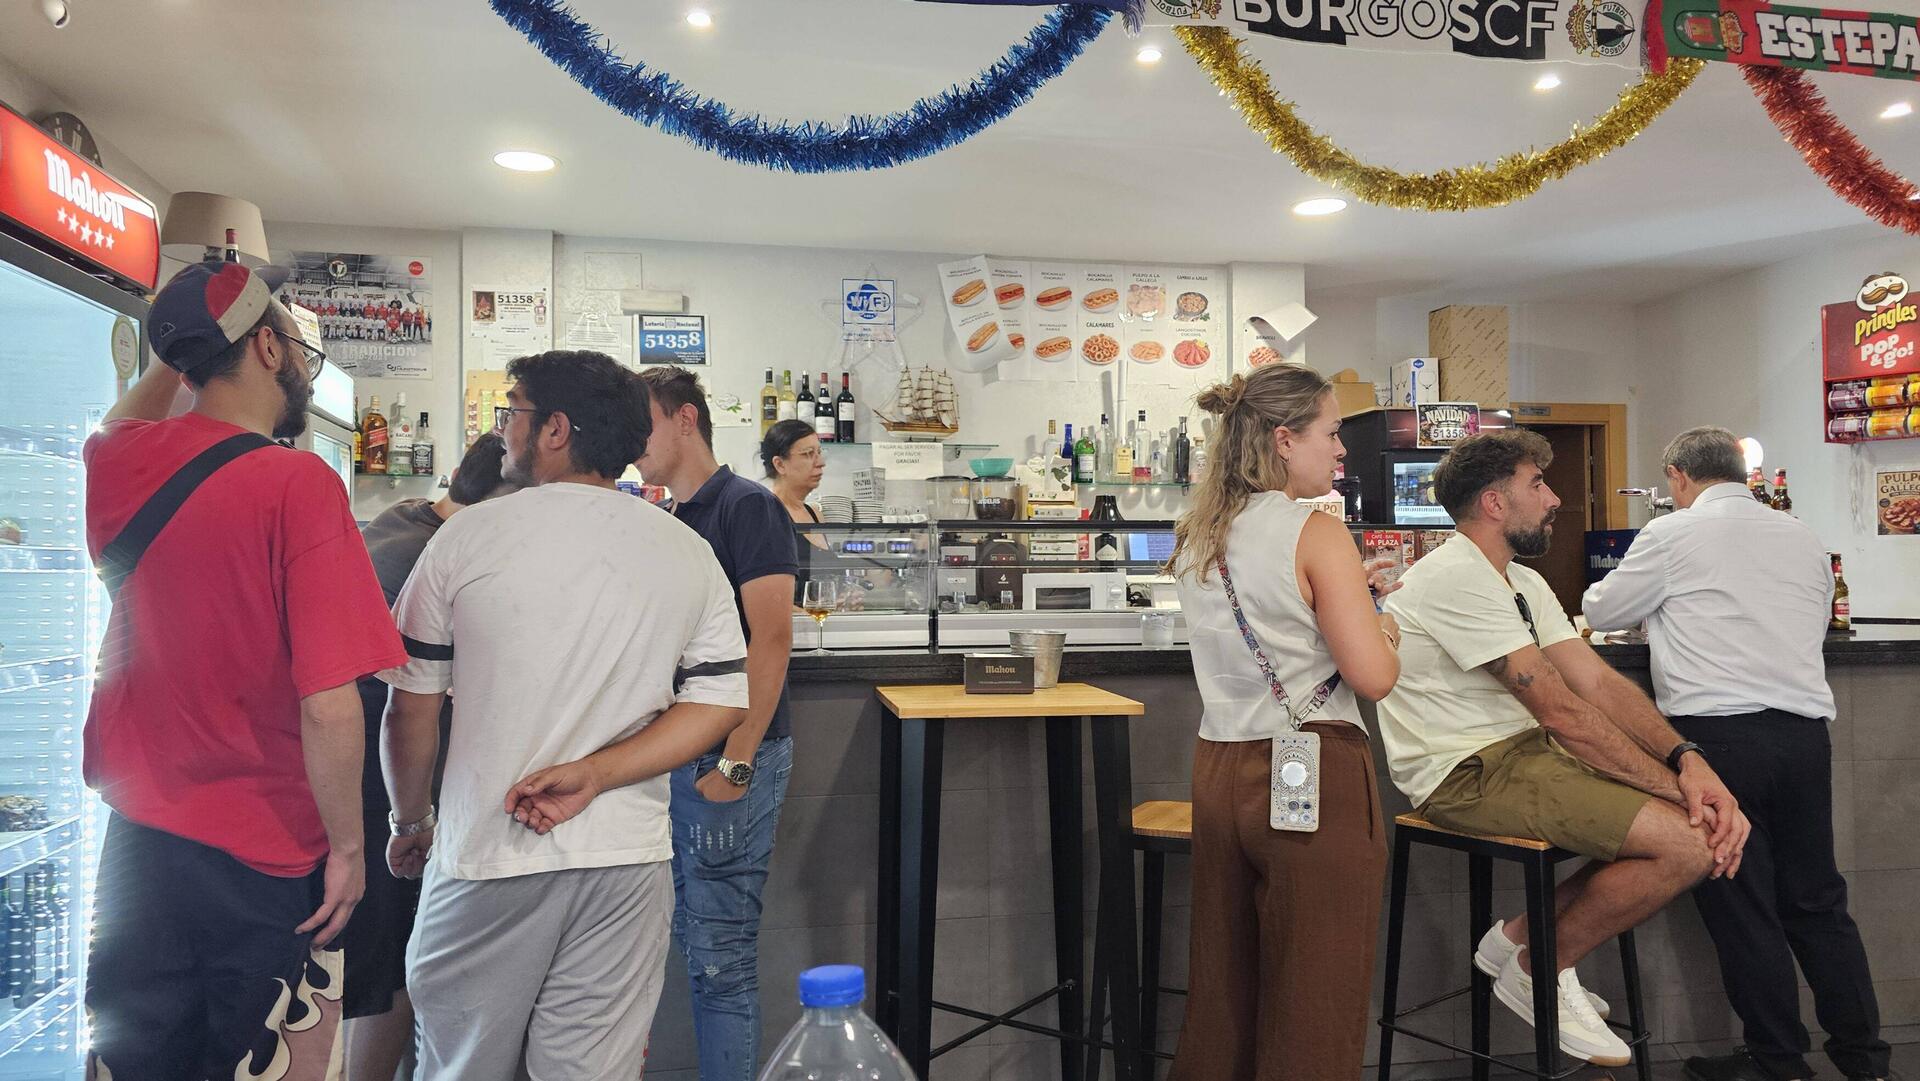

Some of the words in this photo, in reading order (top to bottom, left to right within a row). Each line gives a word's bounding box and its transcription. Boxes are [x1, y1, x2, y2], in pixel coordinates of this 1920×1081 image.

[1602, 4, 1628, 19] FUTBOL
[1601, 41, 1626, 54] BURGOS
[1755, 11, 1920, 73] ESTEPA
[44, 147, 127, 232] Mahou
[497, 294, 534, 304] 51358
[1854, 303, 1918, 346] Pringles
[644, 331, 701, 349] 51358
[1424, 409, 1470, 425] NAVIDAD
[1433, 428, 1465, 439] 51358
[1884, 473, 1920, 484] PULP
[1590, 553, 1625, 569] Maho
[985, 665, 1016, 674] Mahou
